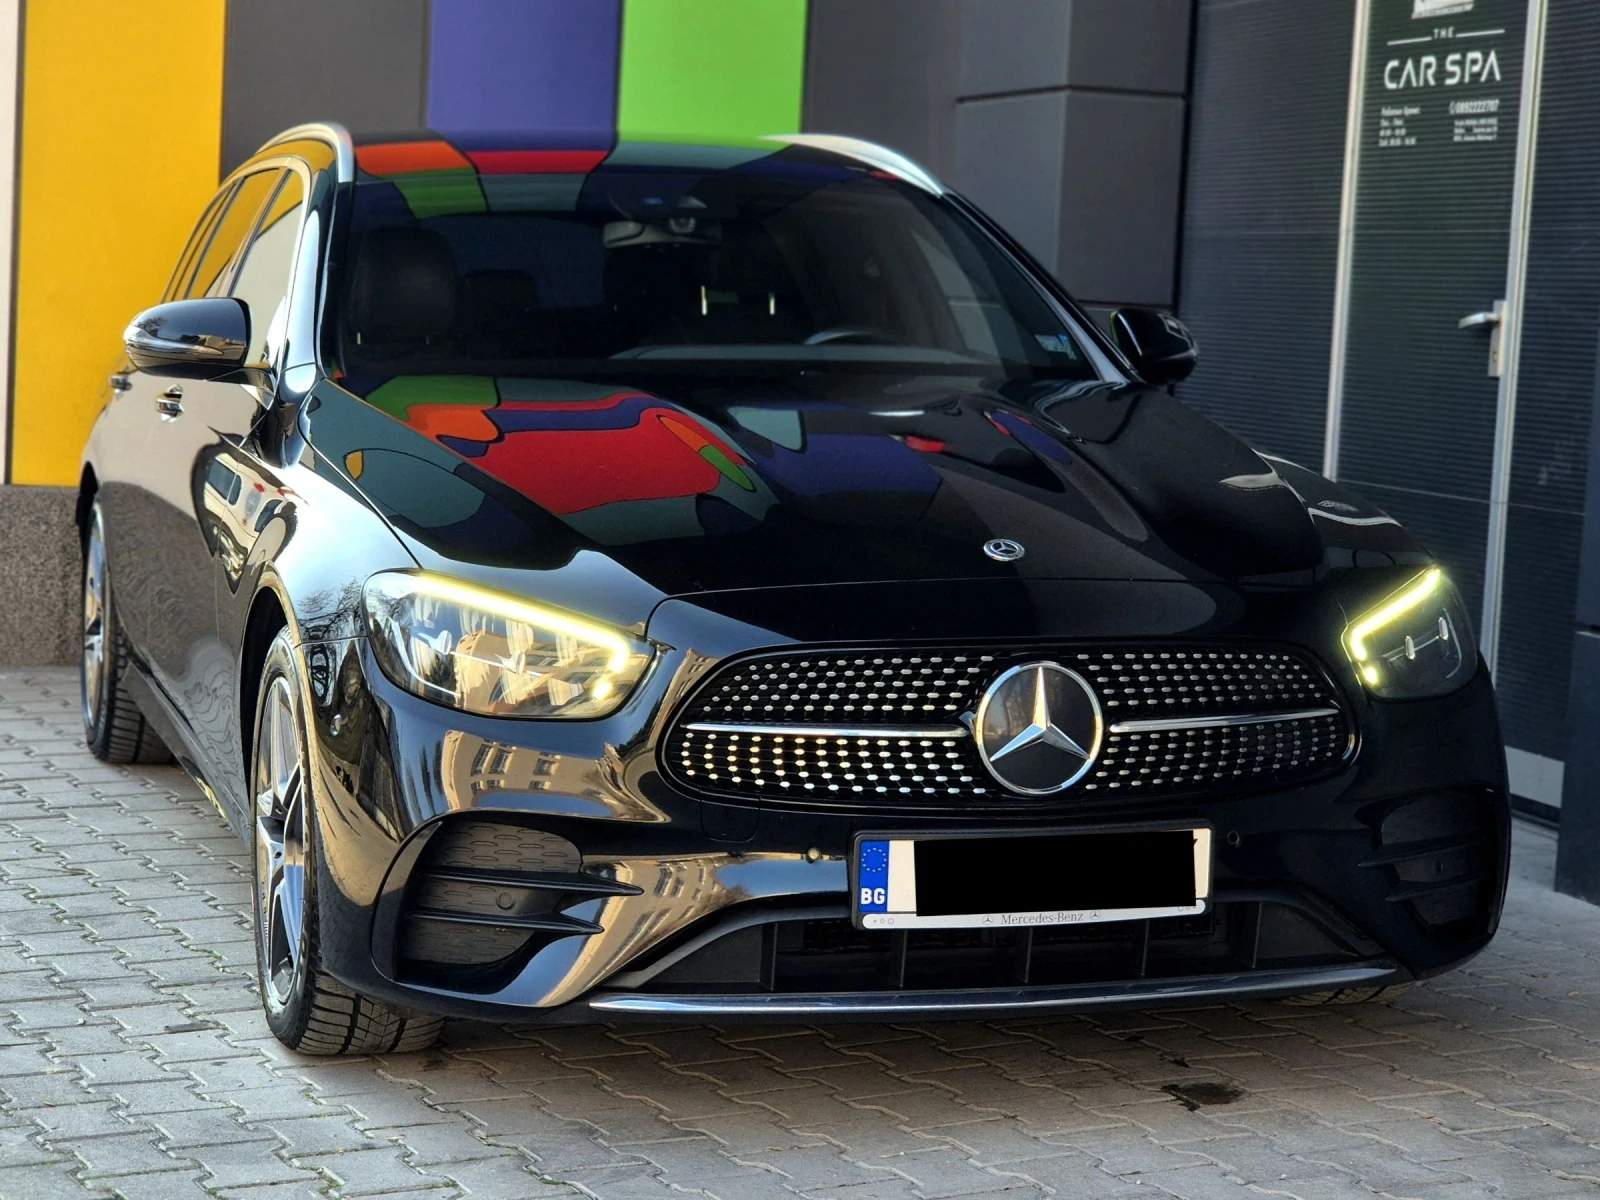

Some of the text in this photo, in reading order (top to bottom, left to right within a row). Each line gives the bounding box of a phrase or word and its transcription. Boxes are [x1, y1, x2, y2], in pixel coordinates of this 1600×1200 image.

[1433, 26, 1455, 39] THE
[1384, 49, 1501, 90] CAR SPA
[860, 887, 886, 905] BG
[1001, 912, 1083, 925] Mercedes-Benz
